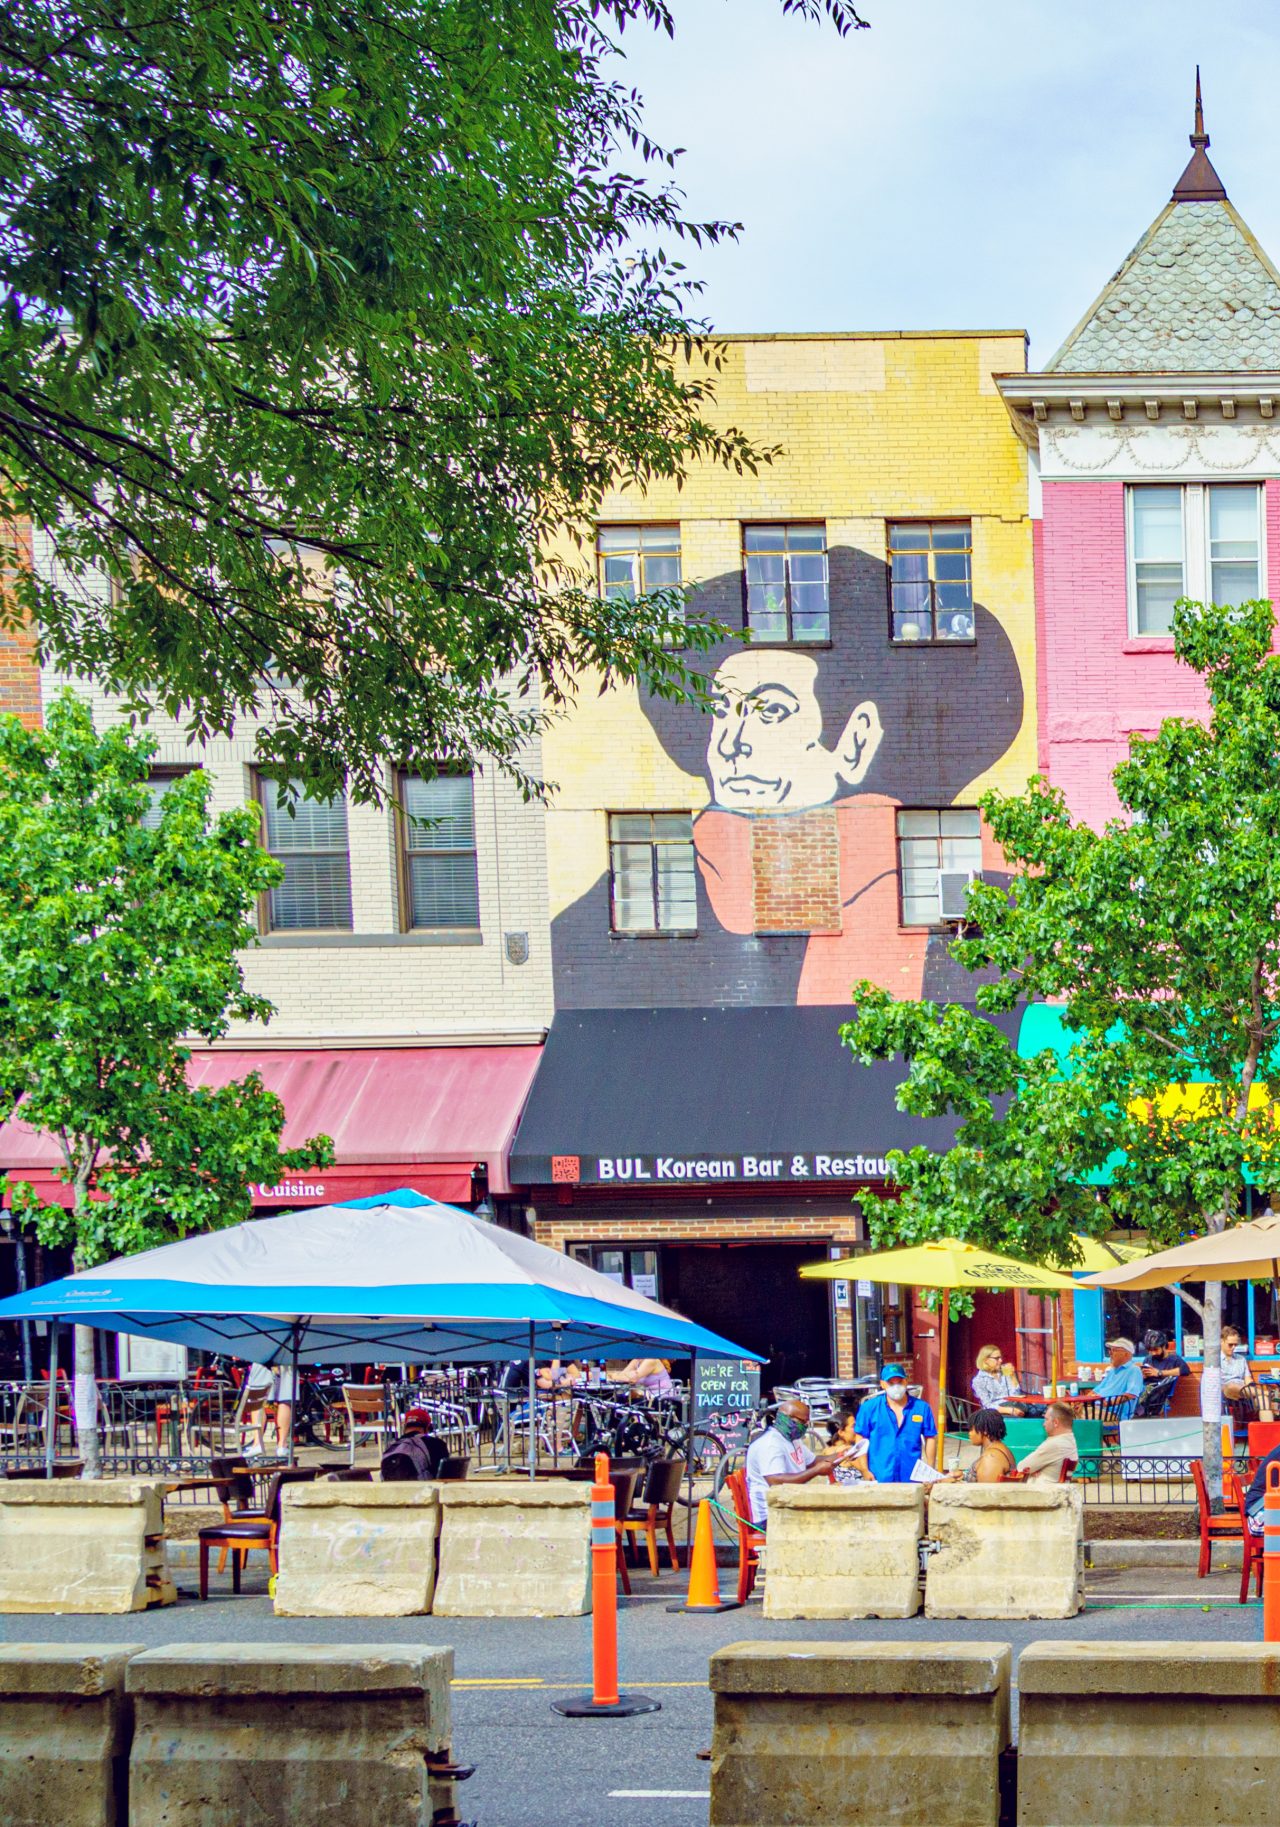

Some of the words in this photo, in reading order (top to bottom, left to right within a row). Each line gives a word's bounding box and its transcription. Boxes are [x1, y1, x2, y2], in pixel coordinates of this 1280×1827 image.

[598, 1158, 650, 1179] BUL
[656, 1157, 735, 1178] Korean
[743, 1156, 782, 1177] Bar
[790, 1155, 808, 1176] &
[815, 1154, 890, 1176] Restau
[260, 1180, 325, 1197] Cuisine
[700, 1364, 734, 1377] WE'RE
[701, 1380, 726, 1391] OPEN
[731, 1380, 749, 1391] FOR
[696, 1393, 724, 1407] TAKE
[727, 1393, 752, 1407] OUT
